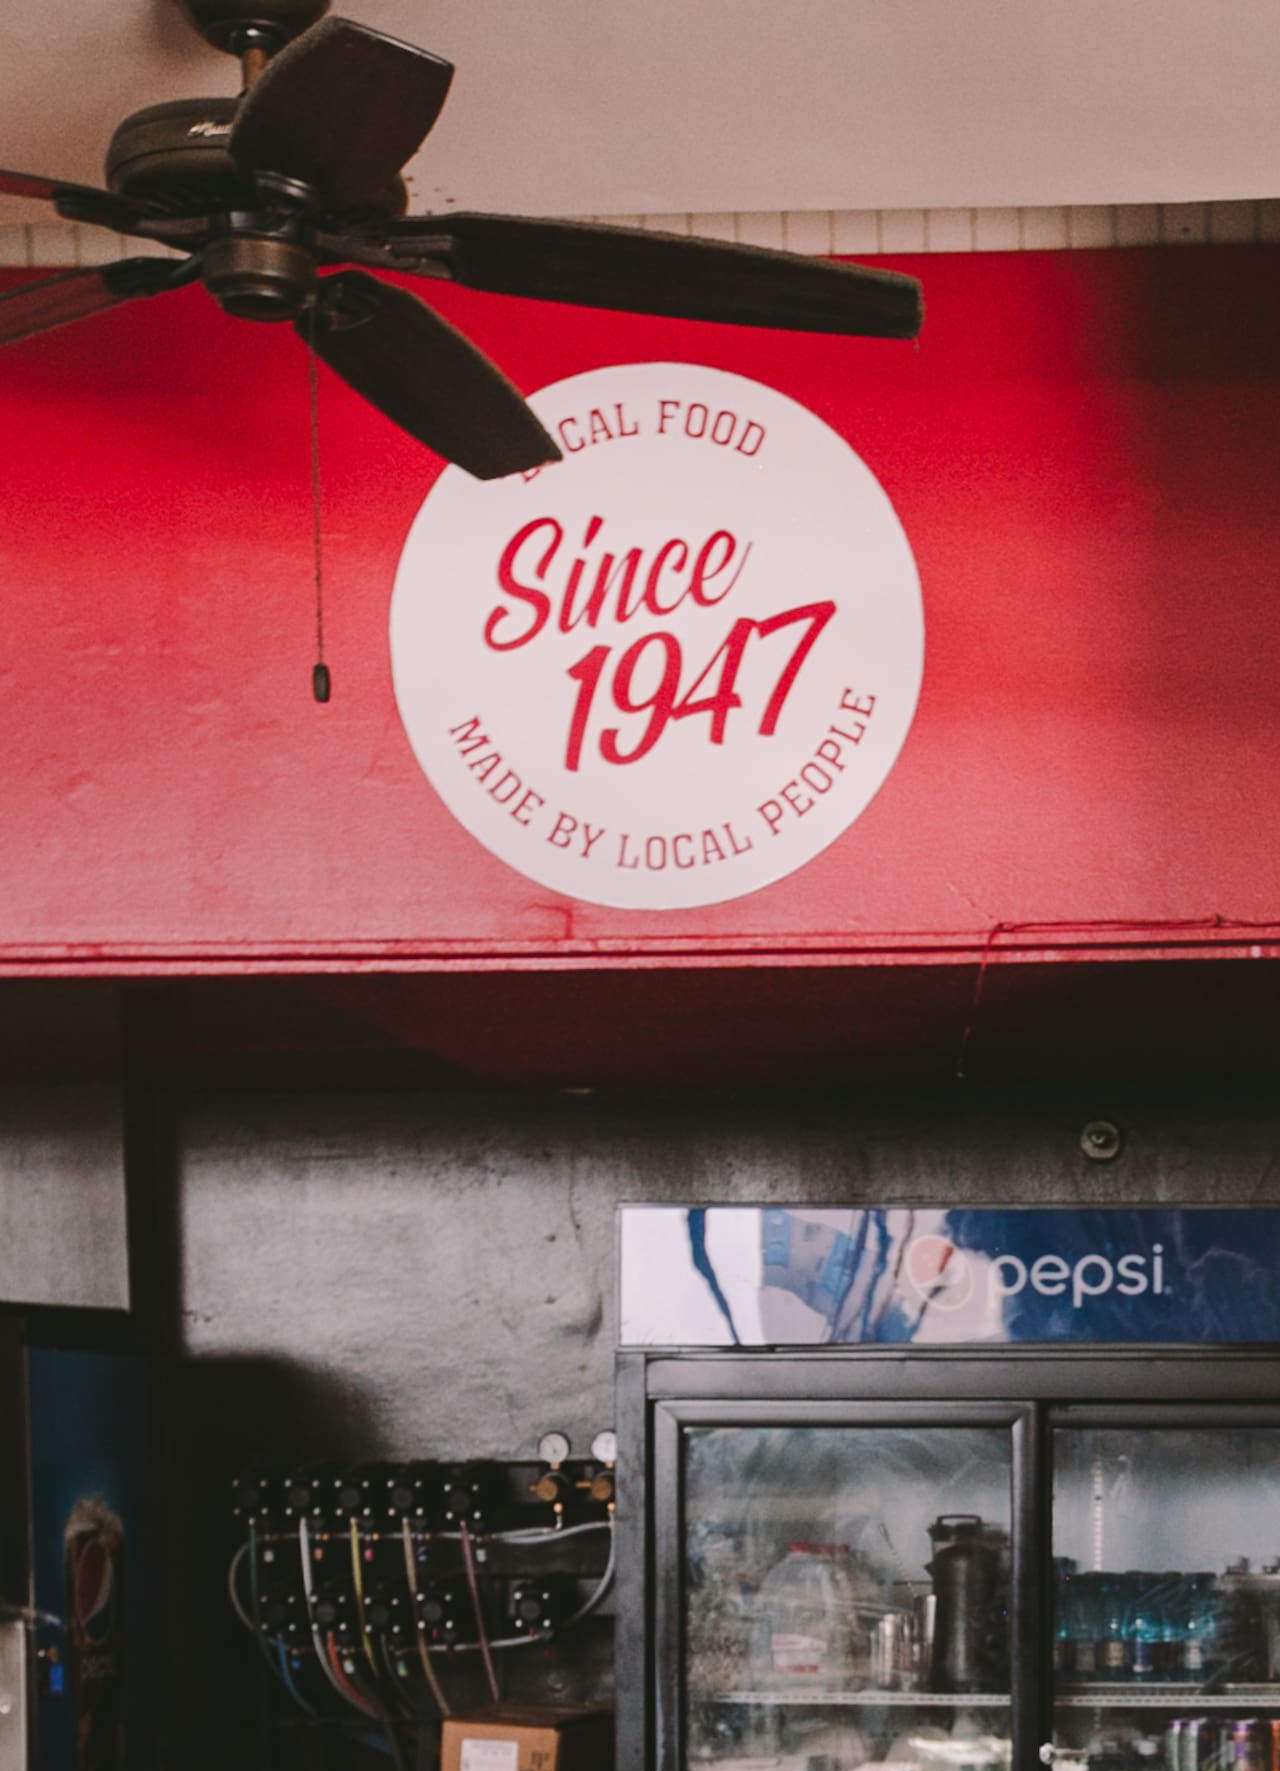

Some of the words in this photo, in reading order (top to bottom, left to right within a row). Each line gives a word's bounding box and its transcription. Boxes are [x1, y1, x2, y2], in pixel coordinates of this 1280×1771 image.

[519, 402, 640, 484] CAL
[657, 400, 767, 457] FOOD
[483, 515, 753, 651] Since
[564, 600, 837, 772] 1947
[449, 716, 546, 826] MADE
[546, 812, 606, 859] BY
[616, 823, 753, 870] LOCAL
[756, 687, 876, 835] PEOPLE
[988, 1244, 1164, 1307] pepsi
